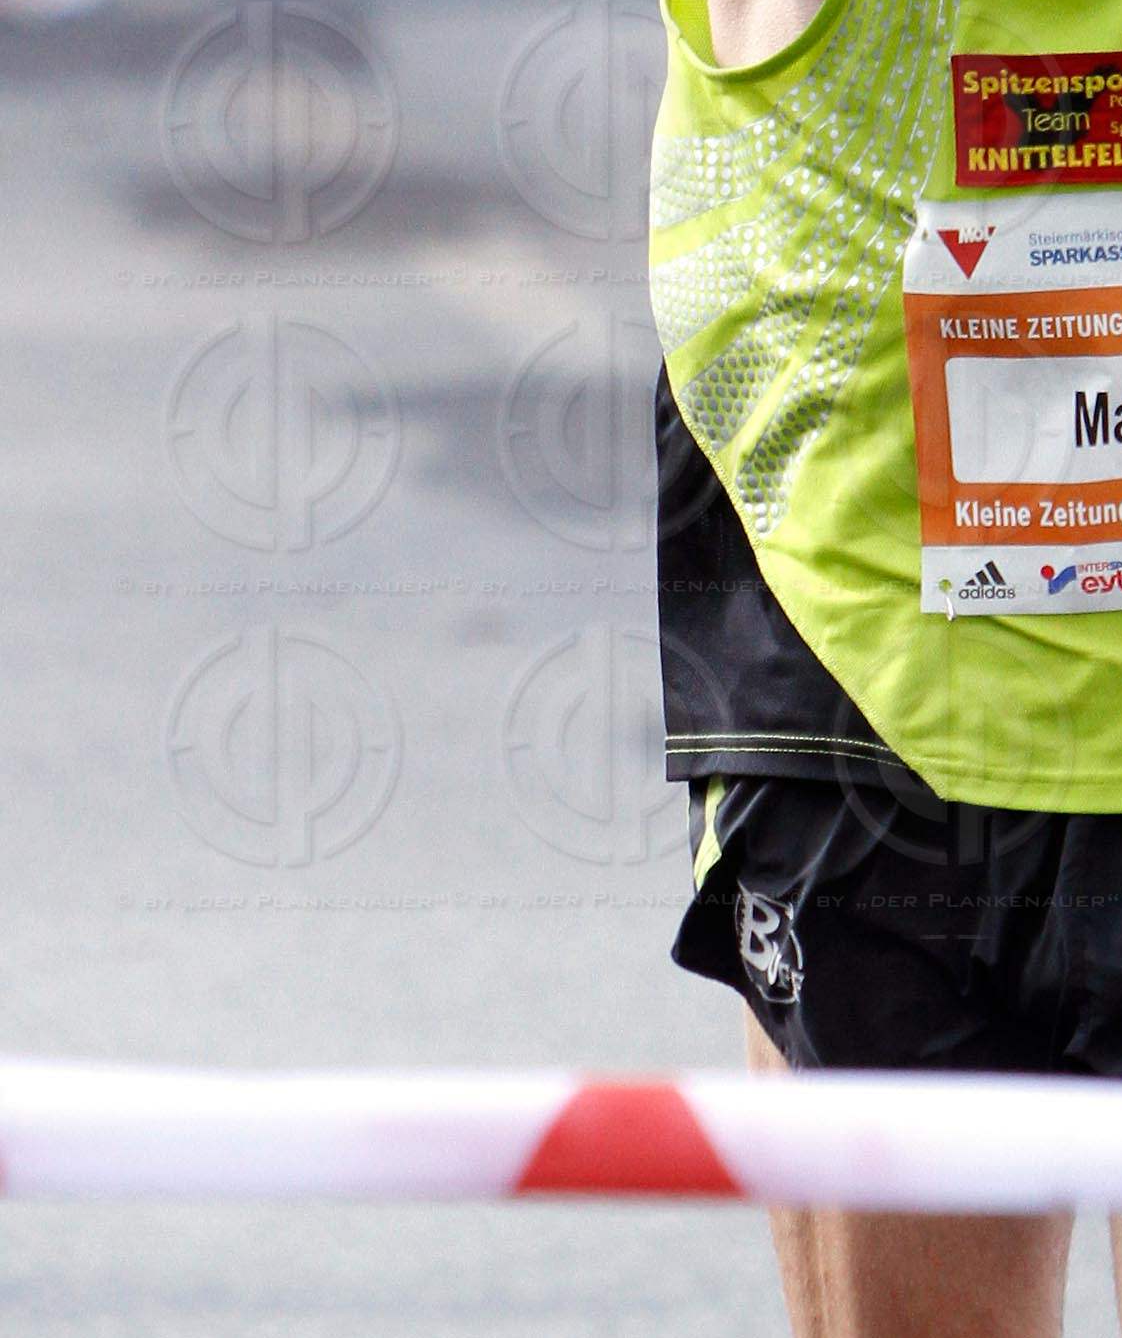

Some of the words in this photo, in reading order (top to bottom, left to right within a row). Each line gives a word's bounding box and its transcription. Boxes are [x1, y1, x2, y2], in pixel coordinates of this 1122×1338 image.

[1022, 108, 1091, 133] Team
[940, 318, 1019, 340] KLEINE
[954, 500, 1031, 527] Kleine
[958, 584, 1016, 600] adidas
